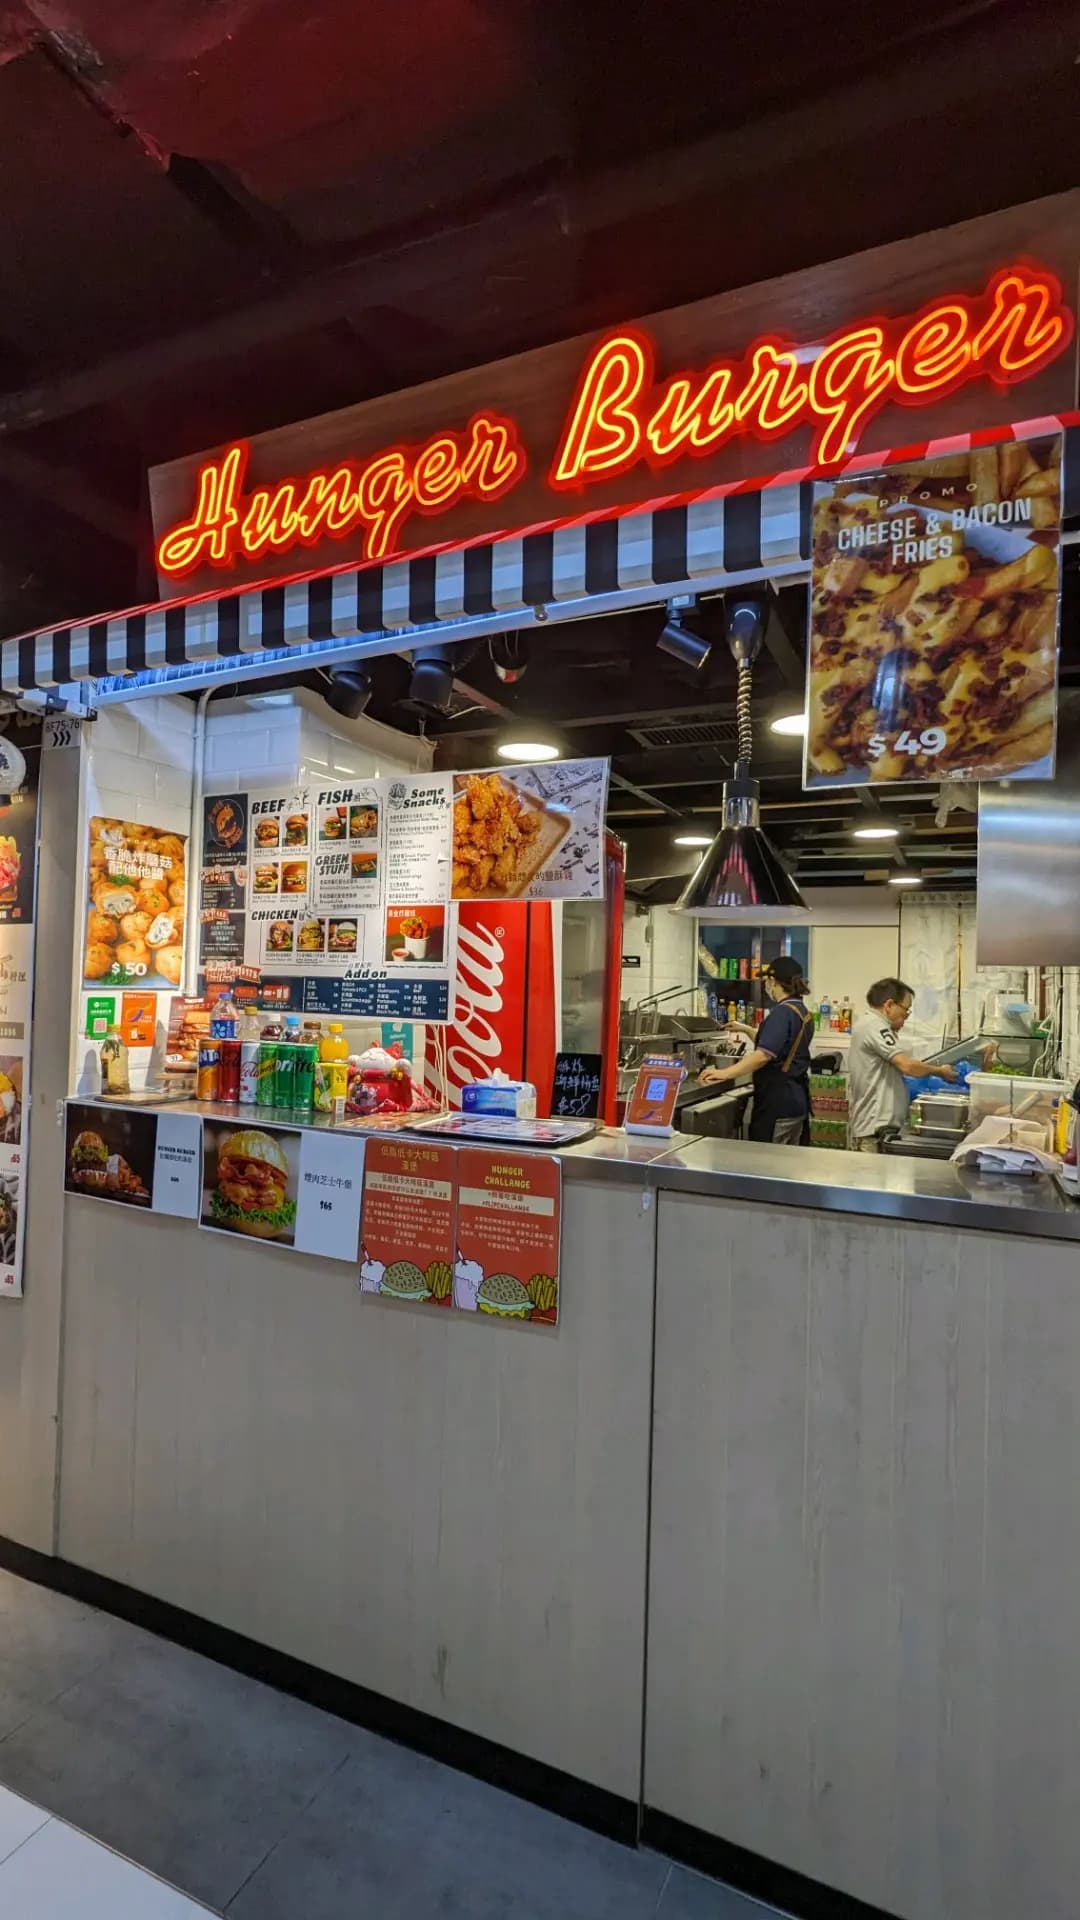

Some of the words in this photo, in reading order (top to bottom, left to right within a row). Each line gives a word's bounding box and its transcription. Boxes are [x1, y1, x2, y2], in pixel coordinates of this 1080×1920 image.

[158, 418, 517, 570] Hunger
[556, 277, 1062, 481] Burger
[879, 483, 977, 508] PROMO
[838, 516, 917, 550] CHEESE
[926, 510, 942, 536] &
[952, 497, 1032, 531] BACON
[892, 535, 953, 566] FRIES
[318, 788, 353, 805] FISH
[411, 788, 444, 799] Some
[251, 799, 287, 815] BEEF
[403, 798, 446, 809] Snacks
[315, 853, 350, 866] GREEN
[319, 863, 350, 876] STUFF
[251, 910, 299, 921] CHICKEN
[880, 1029, 896, 1046] 5
[557, 1094, 591, 1116] $58
[491, 1165, 523, 1177] HUNGER
[484, 1176, 531, 1189] CHALLANGE
